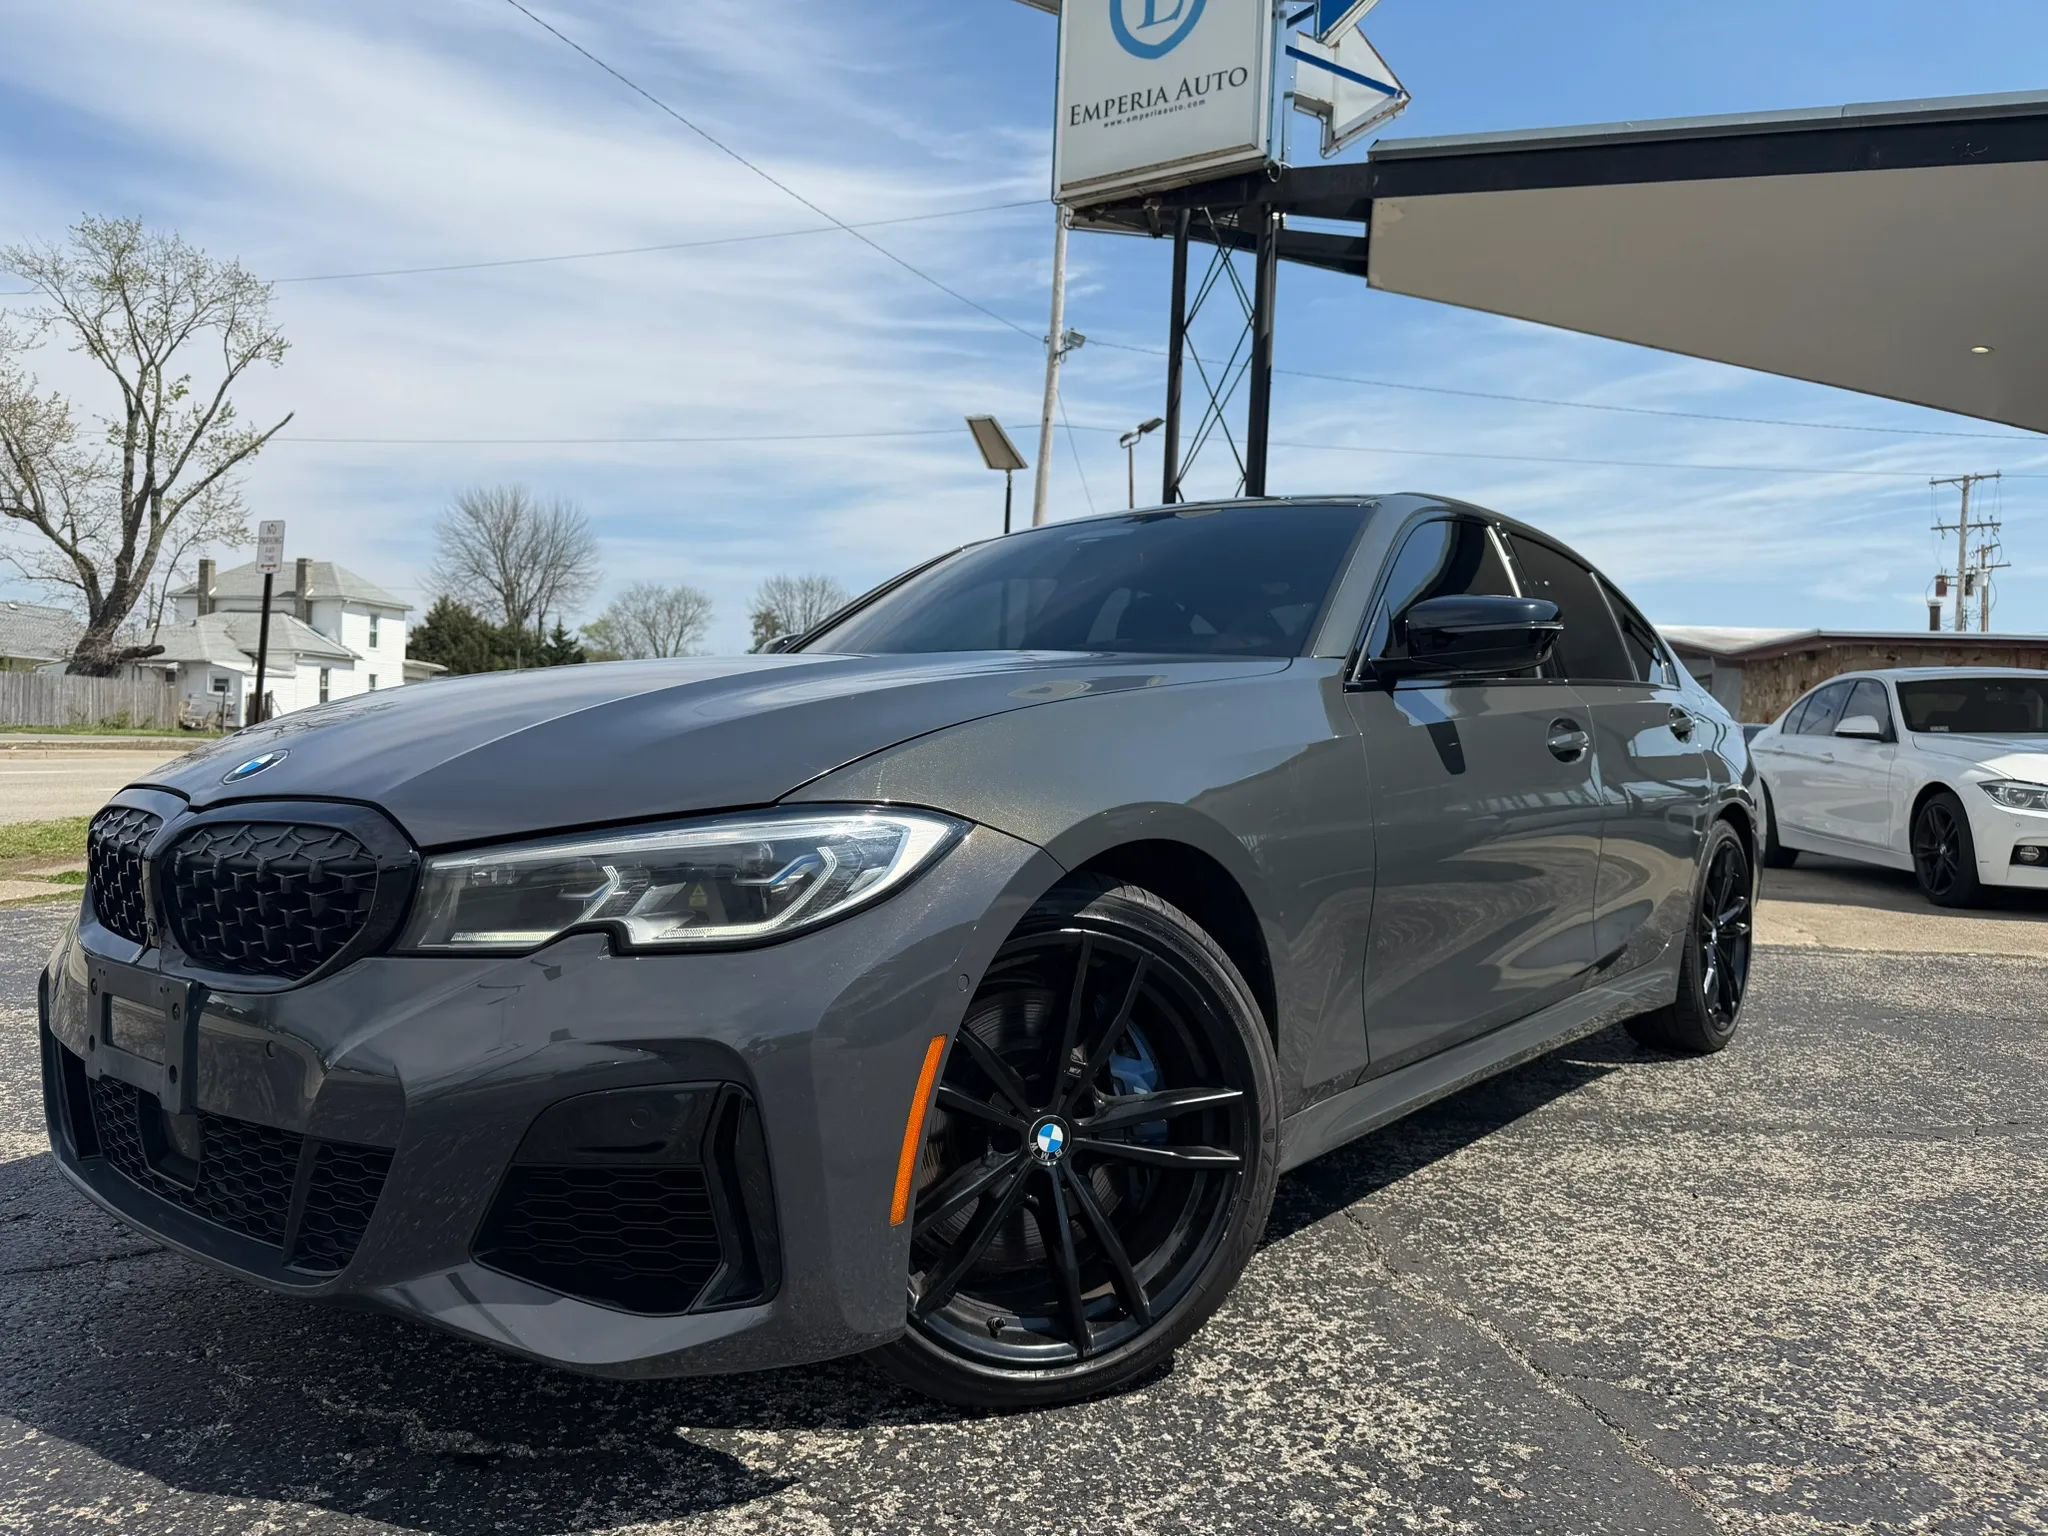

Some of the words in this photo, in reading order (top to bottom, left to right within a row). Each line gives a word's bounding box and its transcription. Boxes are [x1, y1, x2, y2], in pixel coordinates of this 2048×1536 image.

[1070, 87, 1168, 126] EMPERIA
[1176, 67, 1248, 101] AUTO
[1104, 99, 1206, 128] www.emperiaauto.com
[1030, 1142, 1063, 1160] BMW
